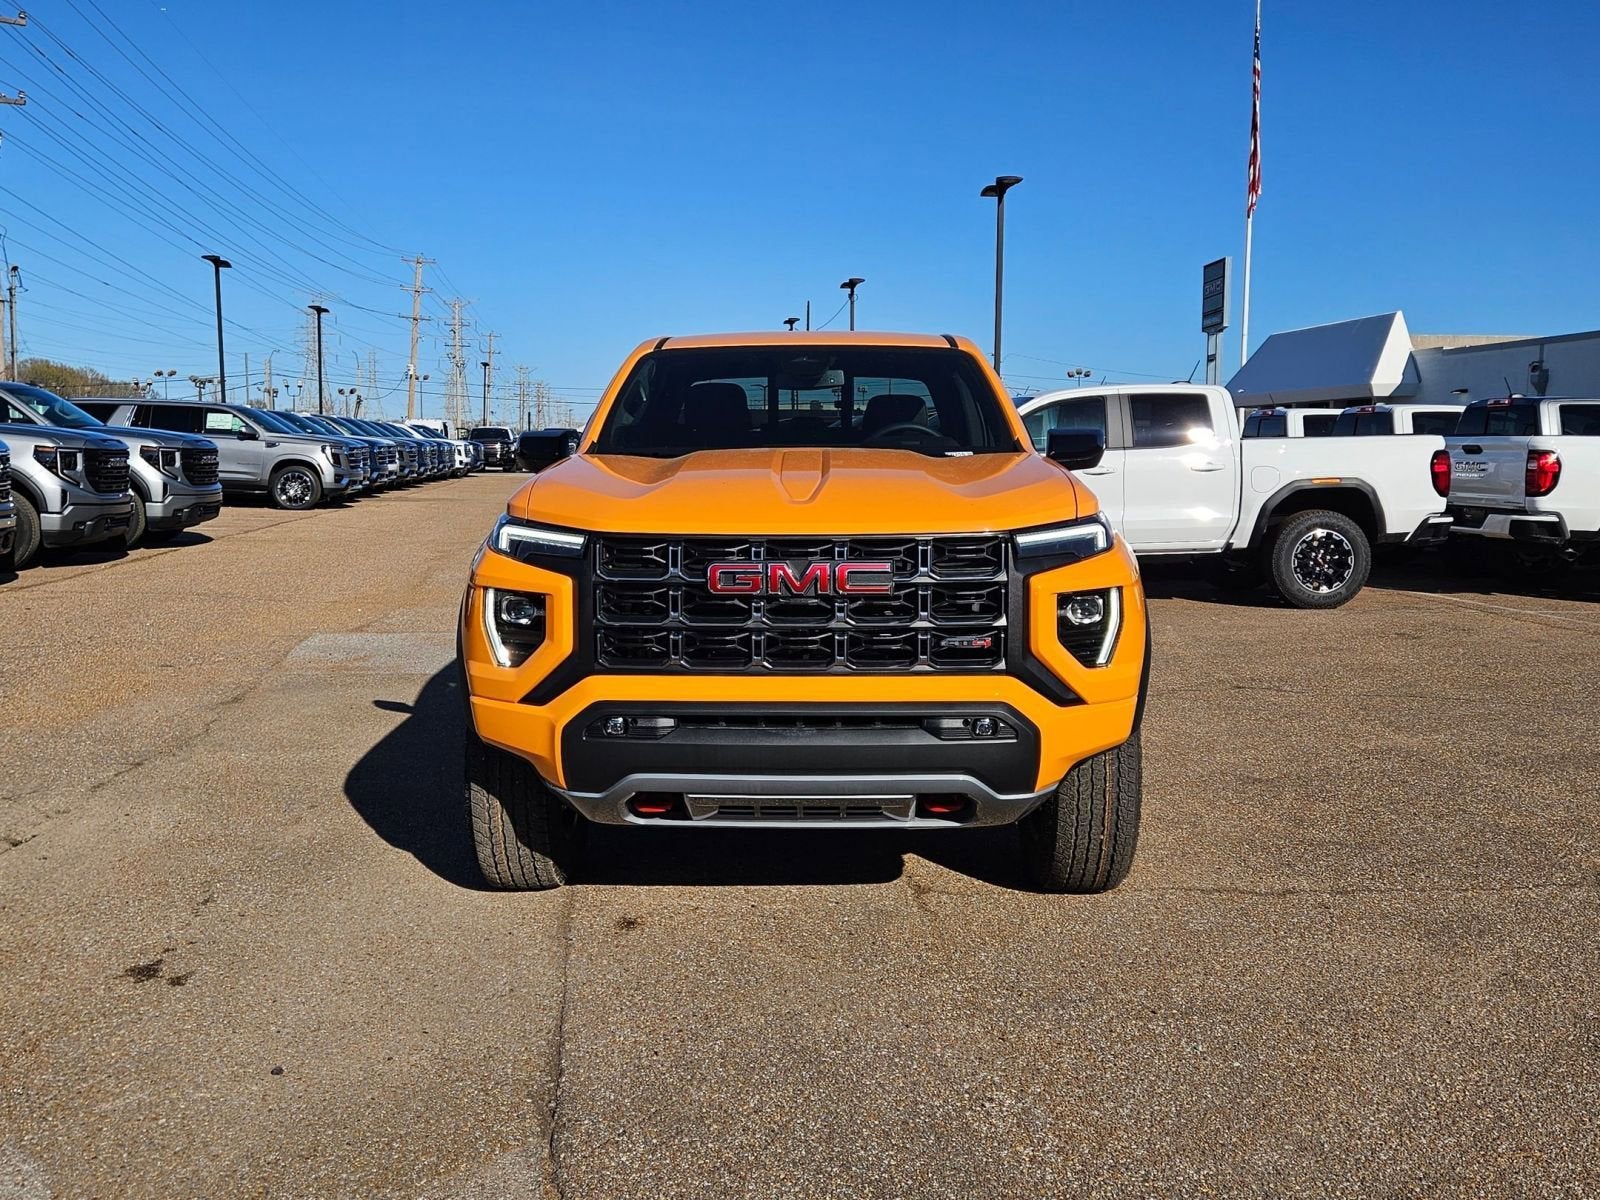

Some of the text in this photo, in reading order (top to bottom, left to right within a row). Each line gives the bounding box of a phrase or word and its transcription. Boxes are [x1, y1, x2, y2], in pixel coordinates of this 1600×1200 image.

[1205, 280, 1222, 294] GMC
[1455, 461, 1488, 472] GMC
[707, 561, 895, 596] GMC
